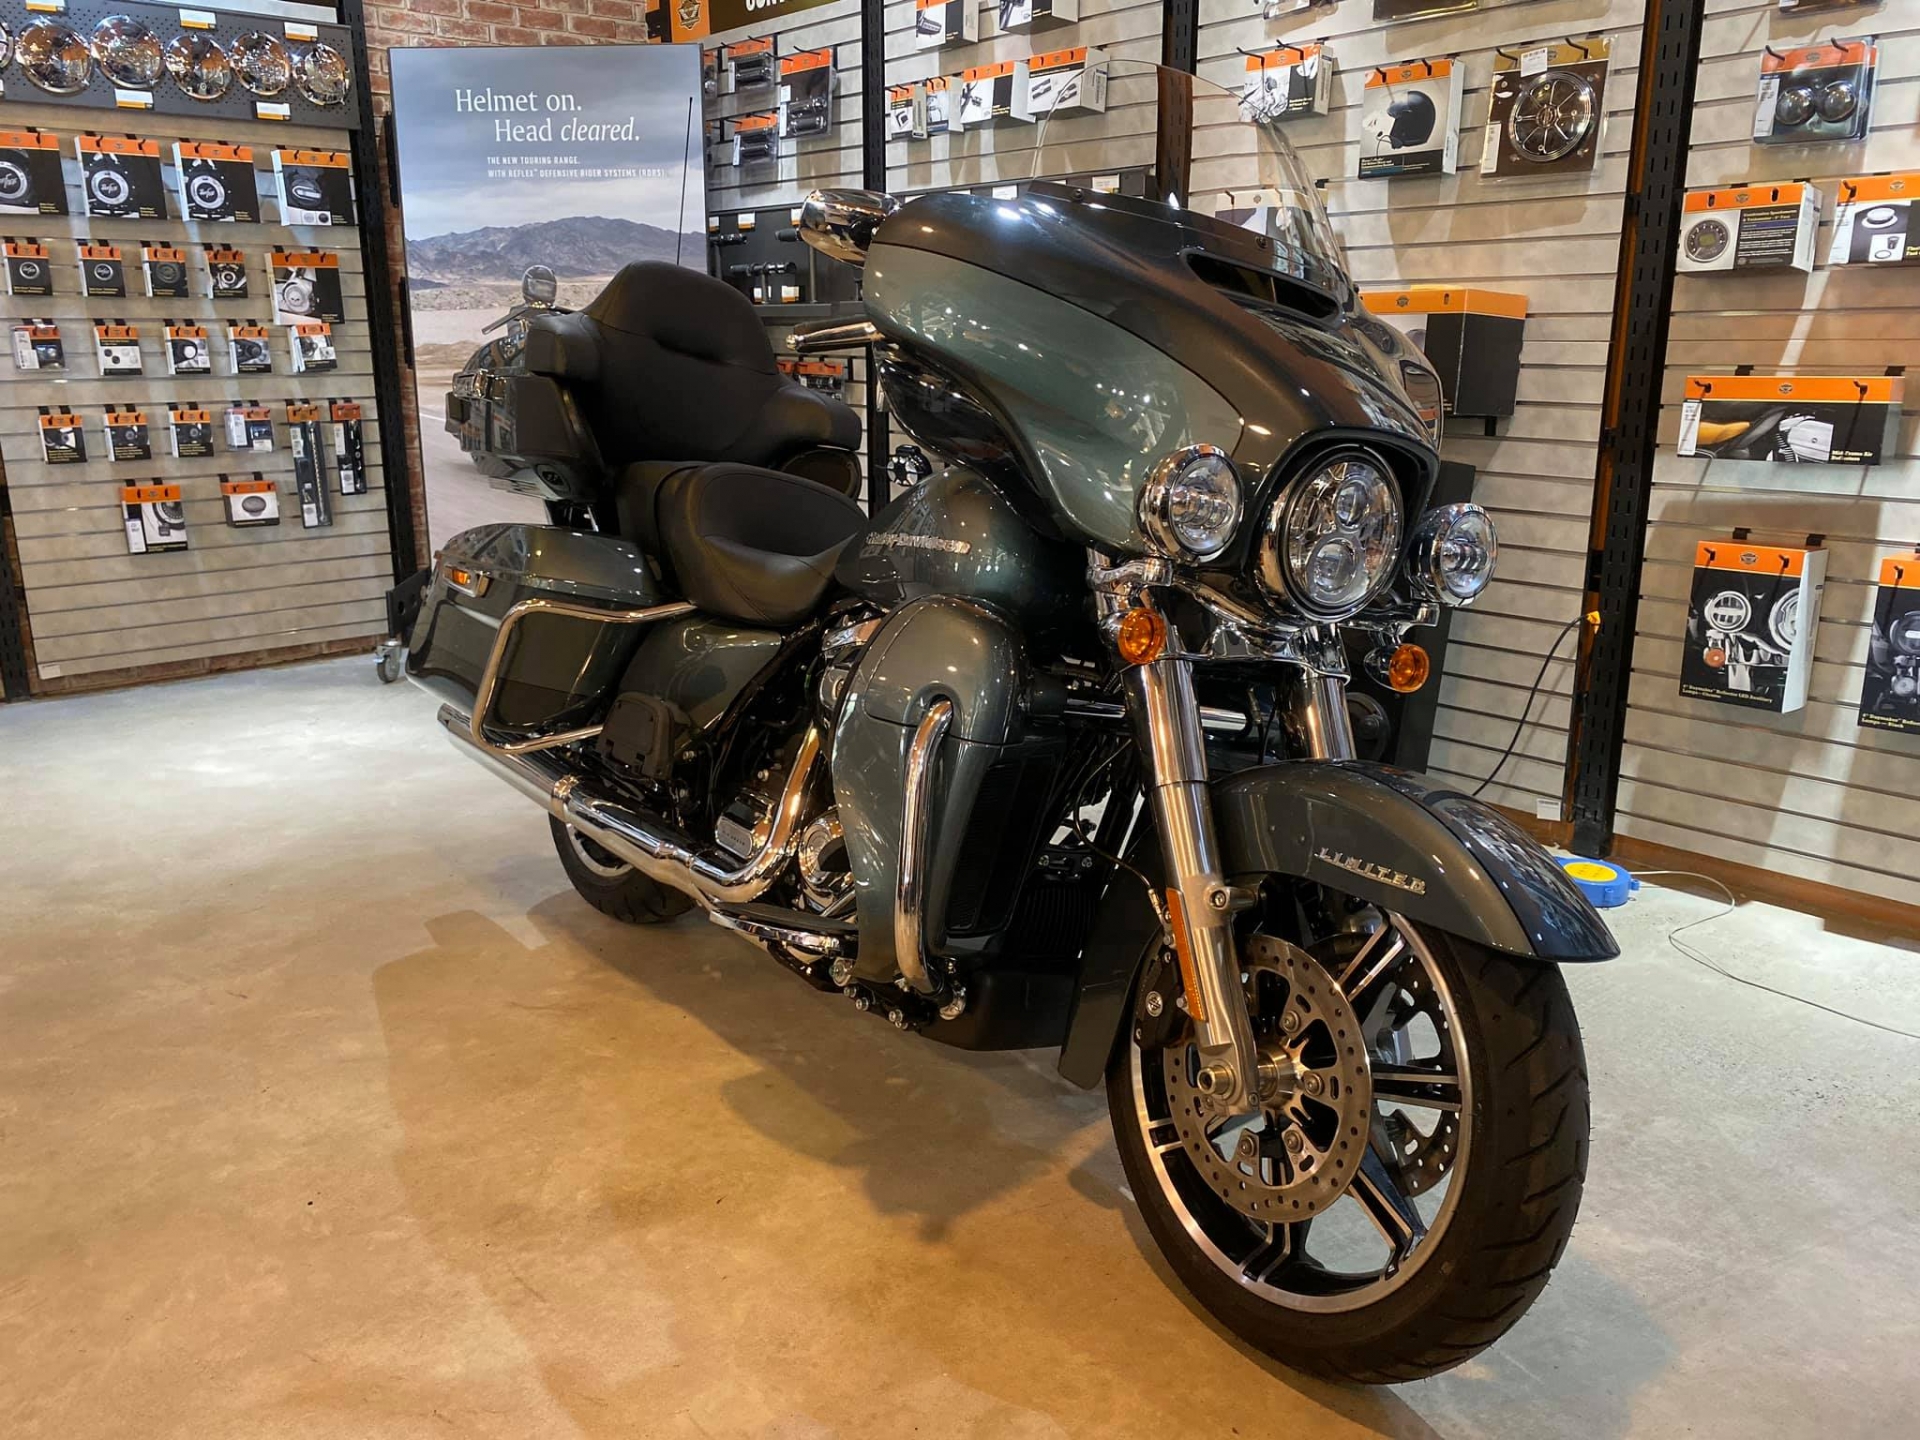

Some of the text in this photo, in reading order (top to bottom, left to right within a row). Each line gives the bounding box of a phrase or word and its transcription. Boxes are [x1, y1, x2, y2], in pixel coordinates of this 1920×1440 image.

[455, 88, 582, 112] Helmet on.
[494, 117, 640, 142] Head cleared.
[487, 156, 581, 165] THE NEW TOURING RANGE.
[487, 169, 506, 178] WITH
[539, 169, 579, 178] DEFENSIVE
[580, 169, 602, 178] RIDER
[603, 169, 637, 178] SYSTEMS
[1318, 847, 1426, 895] LIMITED
